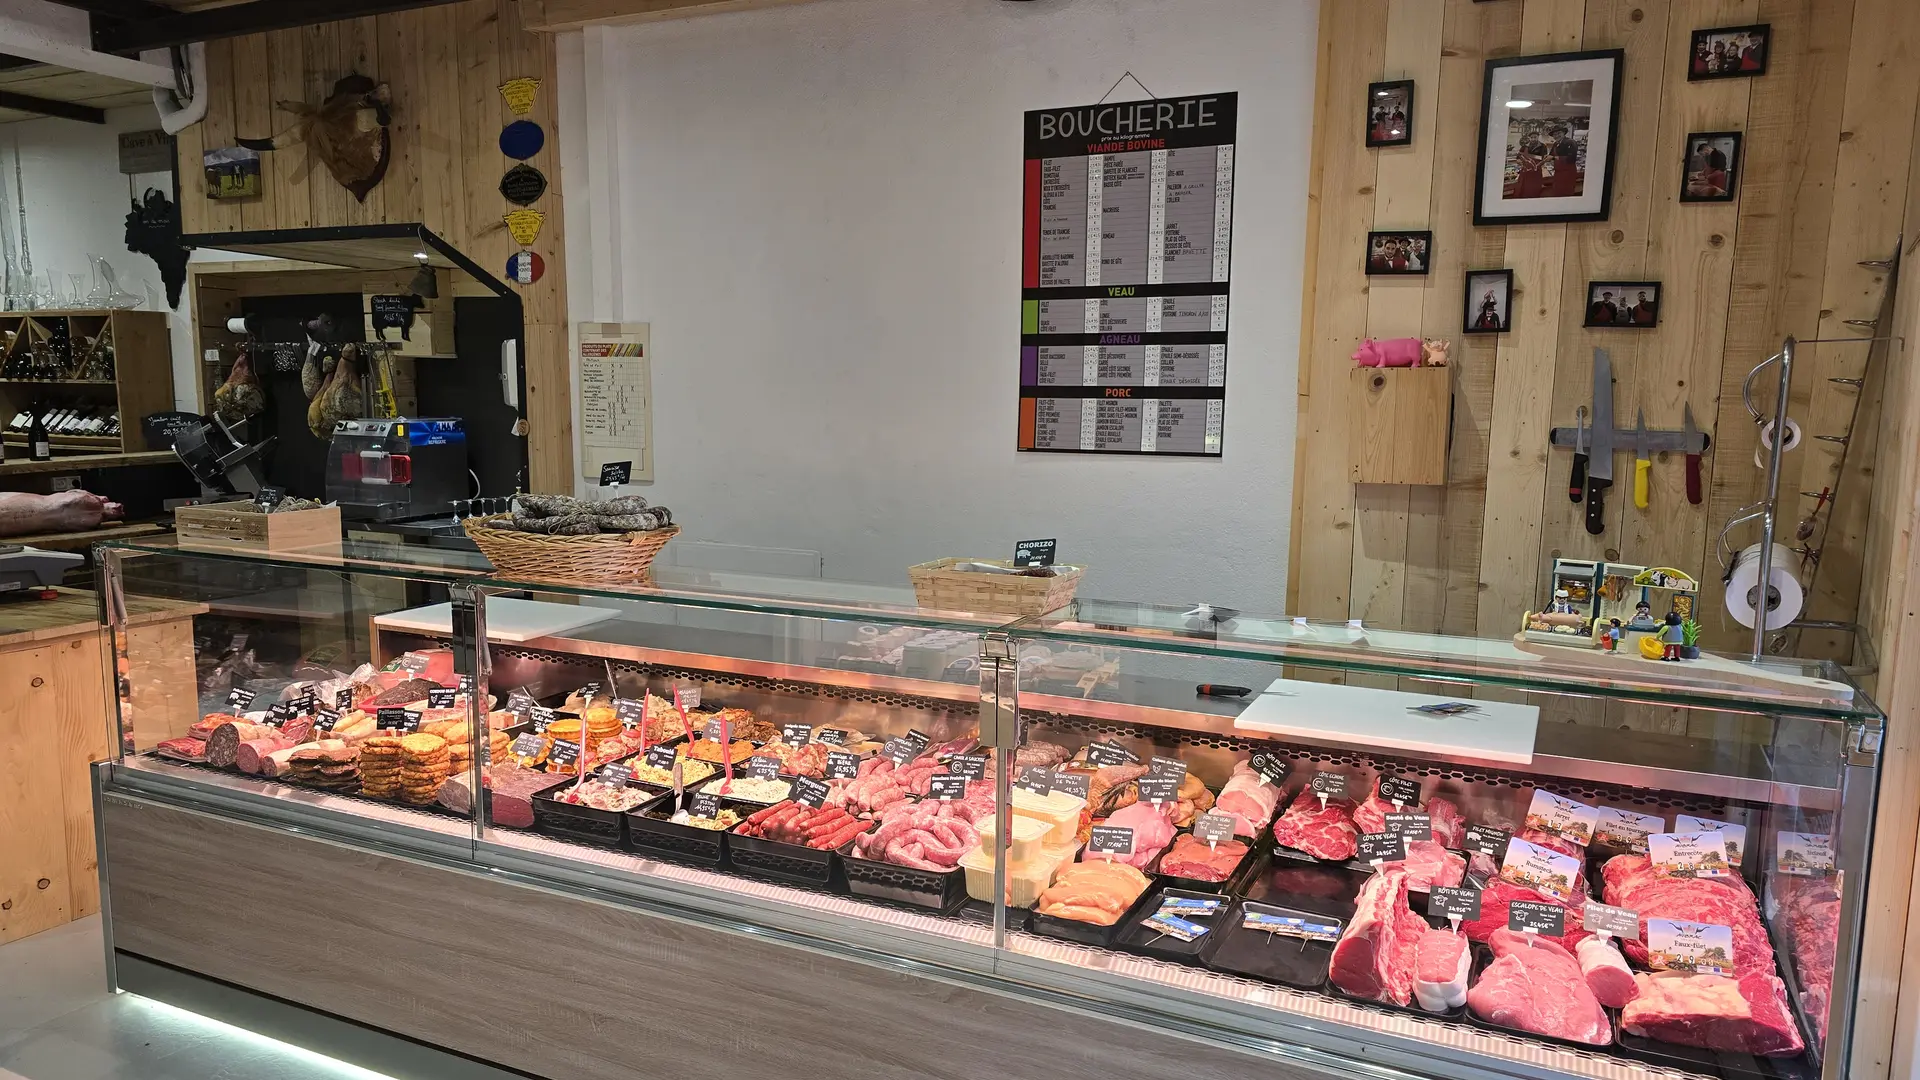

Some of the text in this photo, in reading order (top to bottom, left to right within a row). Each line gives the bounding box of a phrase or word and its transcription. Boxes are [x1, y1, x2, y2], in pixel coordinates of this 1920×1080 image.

[1040, 98, 1217, 140] BOUCHERIE
[122, 137, 145, 149] Cave
[1087, 139, 1165, 153] VIANDE BOVINE
[1108, 287, 1135, 296] VEAU
[1100, 335, 1140, 344] AGNEAU
[1106, 389, 1131, 397] PORC
[1019, 540, 1053, 549] CHORIZO
[654, 746, 674, 755] Taboulé
[799, 776, 826, 792] Merguez
[1554, 812, 1570, 821] Jarret
[1606, 821, 1617, 829] Filet
[1485, 828, 1504, 837] MIGNON
[1526, 860, 1553, 874] Rumsteck
[1511, 902, 1538, 912] ESCALOPE
[1547, 906, 1563, 914] VEAU
[1587, 905, 1604, 913] Filet
[1617, 909, 1637, 919] Veau
[1674, 940, 1707, 949] Faux-filet
